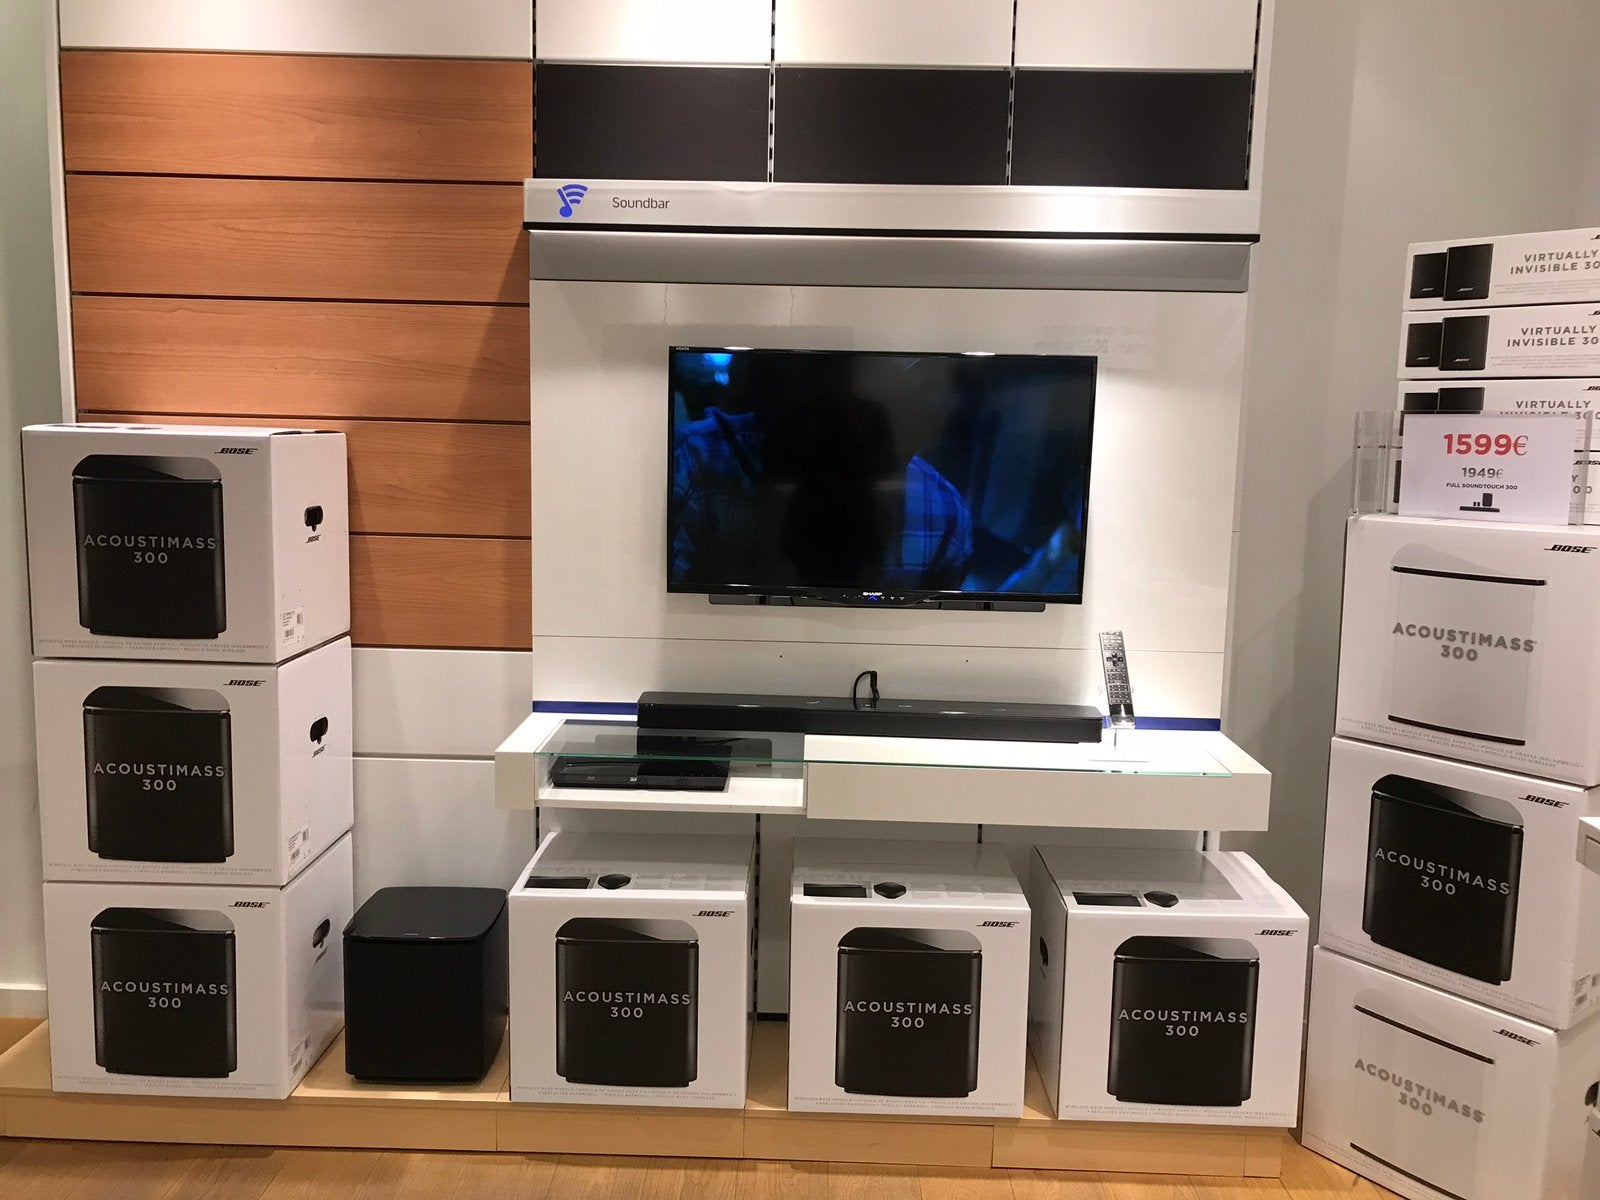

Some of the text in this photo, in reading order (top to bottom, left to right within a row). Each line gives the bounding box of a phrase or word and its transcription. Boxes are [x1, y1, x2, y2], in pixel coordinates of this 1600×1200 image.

[612, 196, 670, 209] Soundbar
[1523, 249, 1599, 262] VIRTUALLY
[1510, 262, 1578, 275] INVISIBLE
[1521, 325, 1597, 336] VIRTUALLY
[1507, 337, 1576, 347] INVISIBLE
[1516, 400, 1591, 409] VIRTUALLY
[214, 447, 258, 455] BOSE
[1444, 433, 1529, 456] 1599€
[1462, 467, 1504, 479] 1949€
[84, 534, 217, 550] ACOUSTIMASS
[1544, 544, 1598, 554] BOSE
[133, 552, 169, 564] 300
[1392, 622, 1536, 653] ACOUSTIMASS
[1441, 645, 1478, 662] 300
[223, 679, 266, 687] BOSE
[93, 763, 225, 778] ACOUSTIMASS
[142, 779, 177, 792] 300
[1518, 794, 1569, 809] BOSE
[1374, 847, 1510, 896] ACOUSTIMASS
[1420, 876, 1456, 896] 300
[228, 901, 270, 909] BOSE
[976, 920, 1019, 928] BOSE
[1254, 929, 1298, 937] BOSE
[101, 981, 229, 995] ACOUSTIMASS
[148, 996, 182, 1009] 300
[563, 991, 691, 1005] ACOUSTIMASS
[610, 1007, 644, 1019] 300
[844, 1001, 972, 1015] ACOUSTIMASS
[891, 1017, 925, 1028] 300
[1118, 1009, 1248, 1023] ACOUSTIMASS
[1166, 1025, 1199, 1037] 300
[1492, 1028, 1541, 1047] BOSE
[1354, 1058, 1484, 1124] ACOUSTIMASS
[1398, 1092, 1433, 1116] 300
